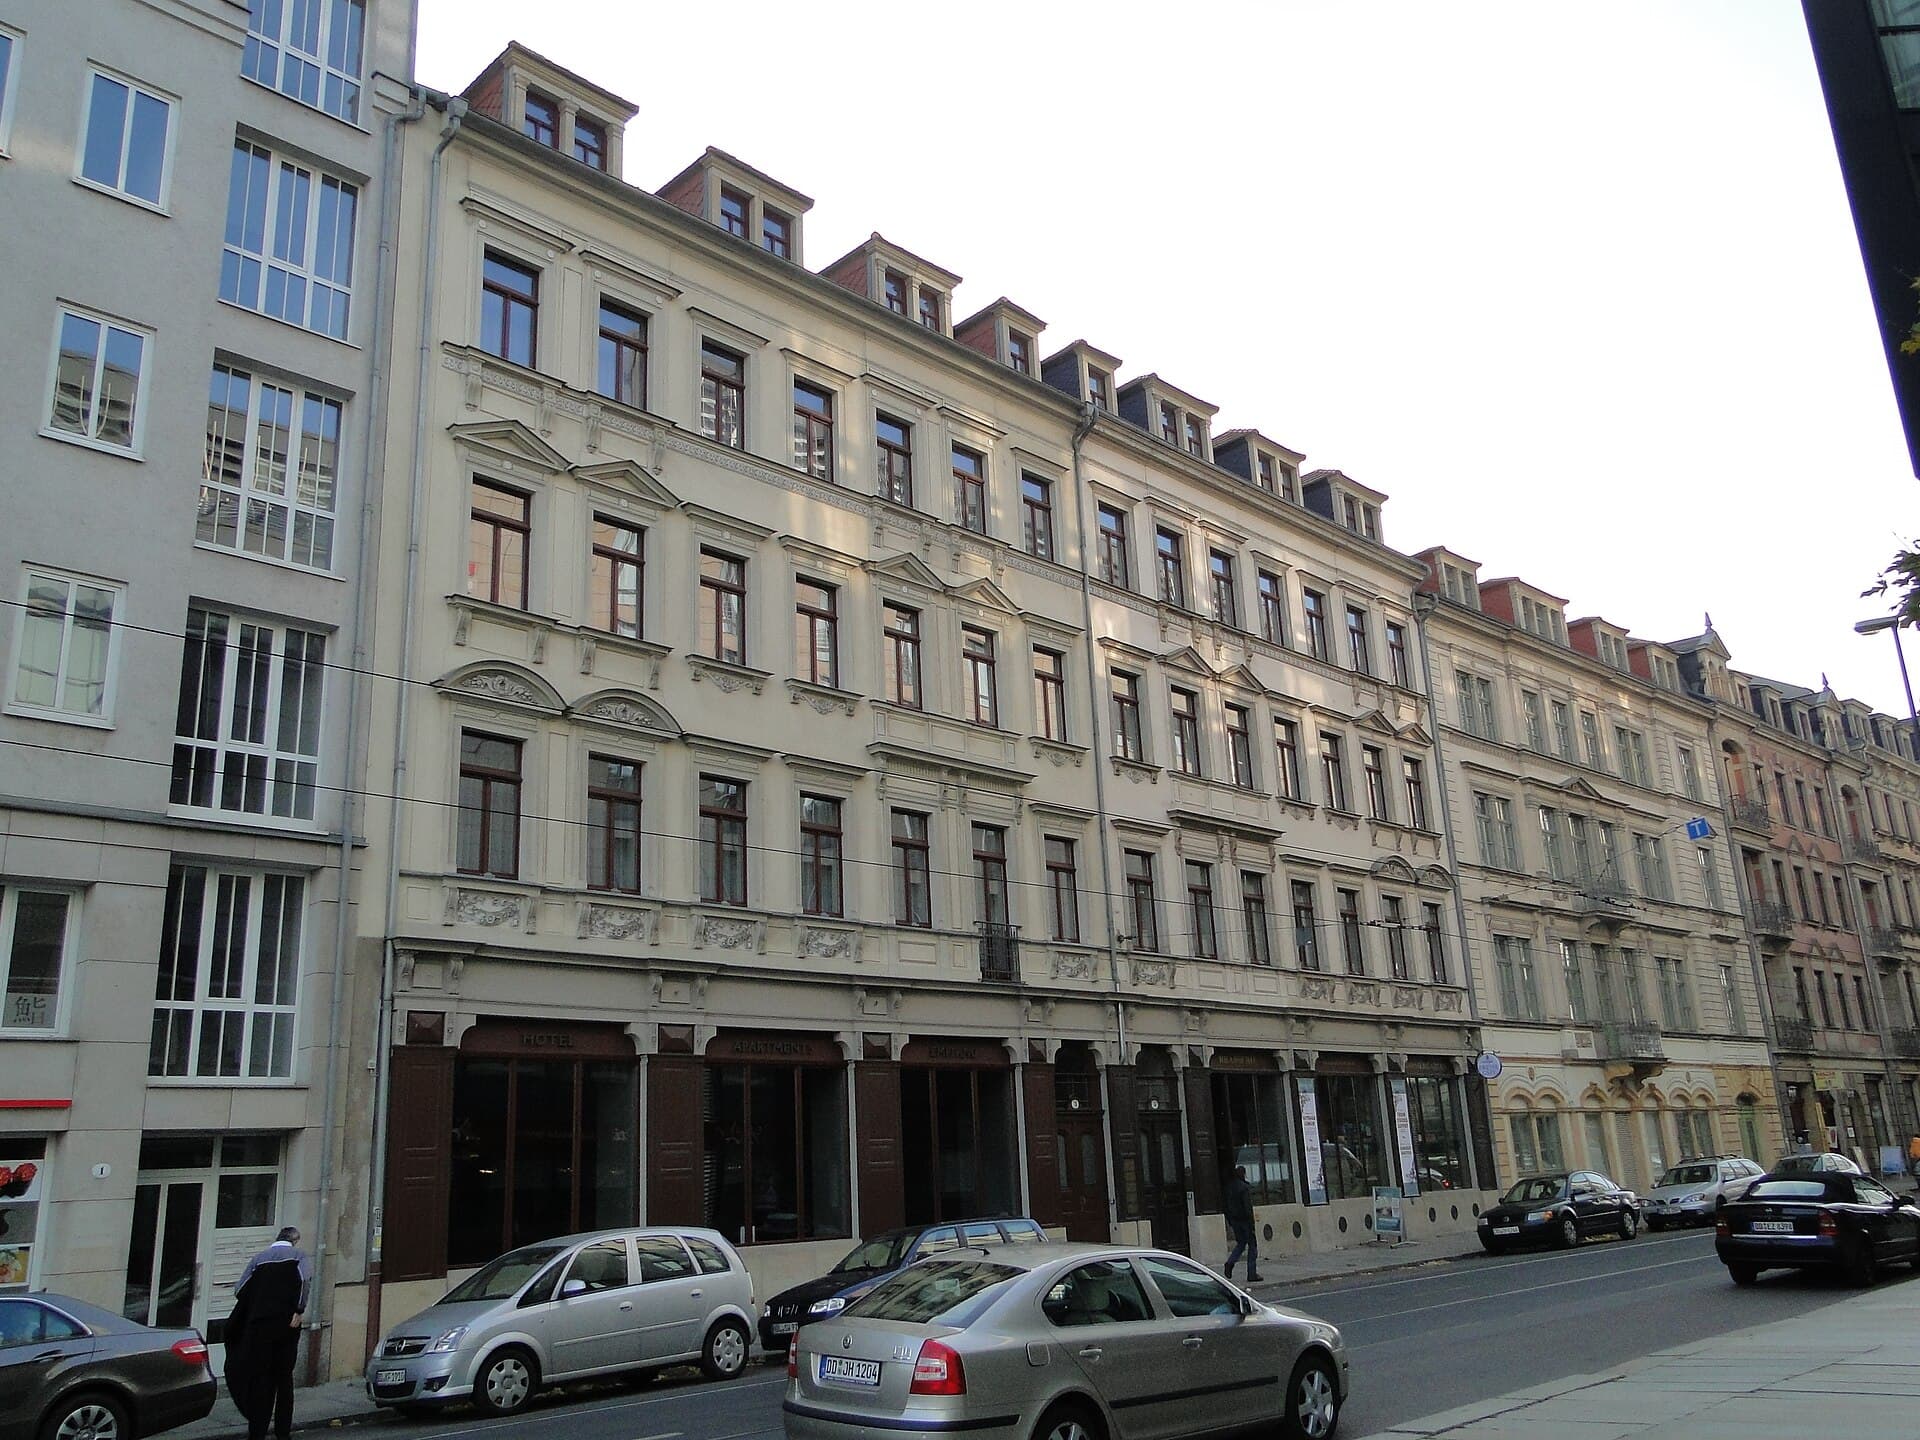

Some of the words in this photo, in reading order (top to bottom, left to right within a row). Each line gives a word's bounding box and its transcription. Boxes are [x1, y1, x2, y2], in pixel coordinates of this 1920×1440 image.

[521, 1032, 577, 1048] HOTEL
[826, 1359, 838, 1374] DD
[843, 1361, 855, 1376] JH
[855, 1363, 877, 1380] 1204
